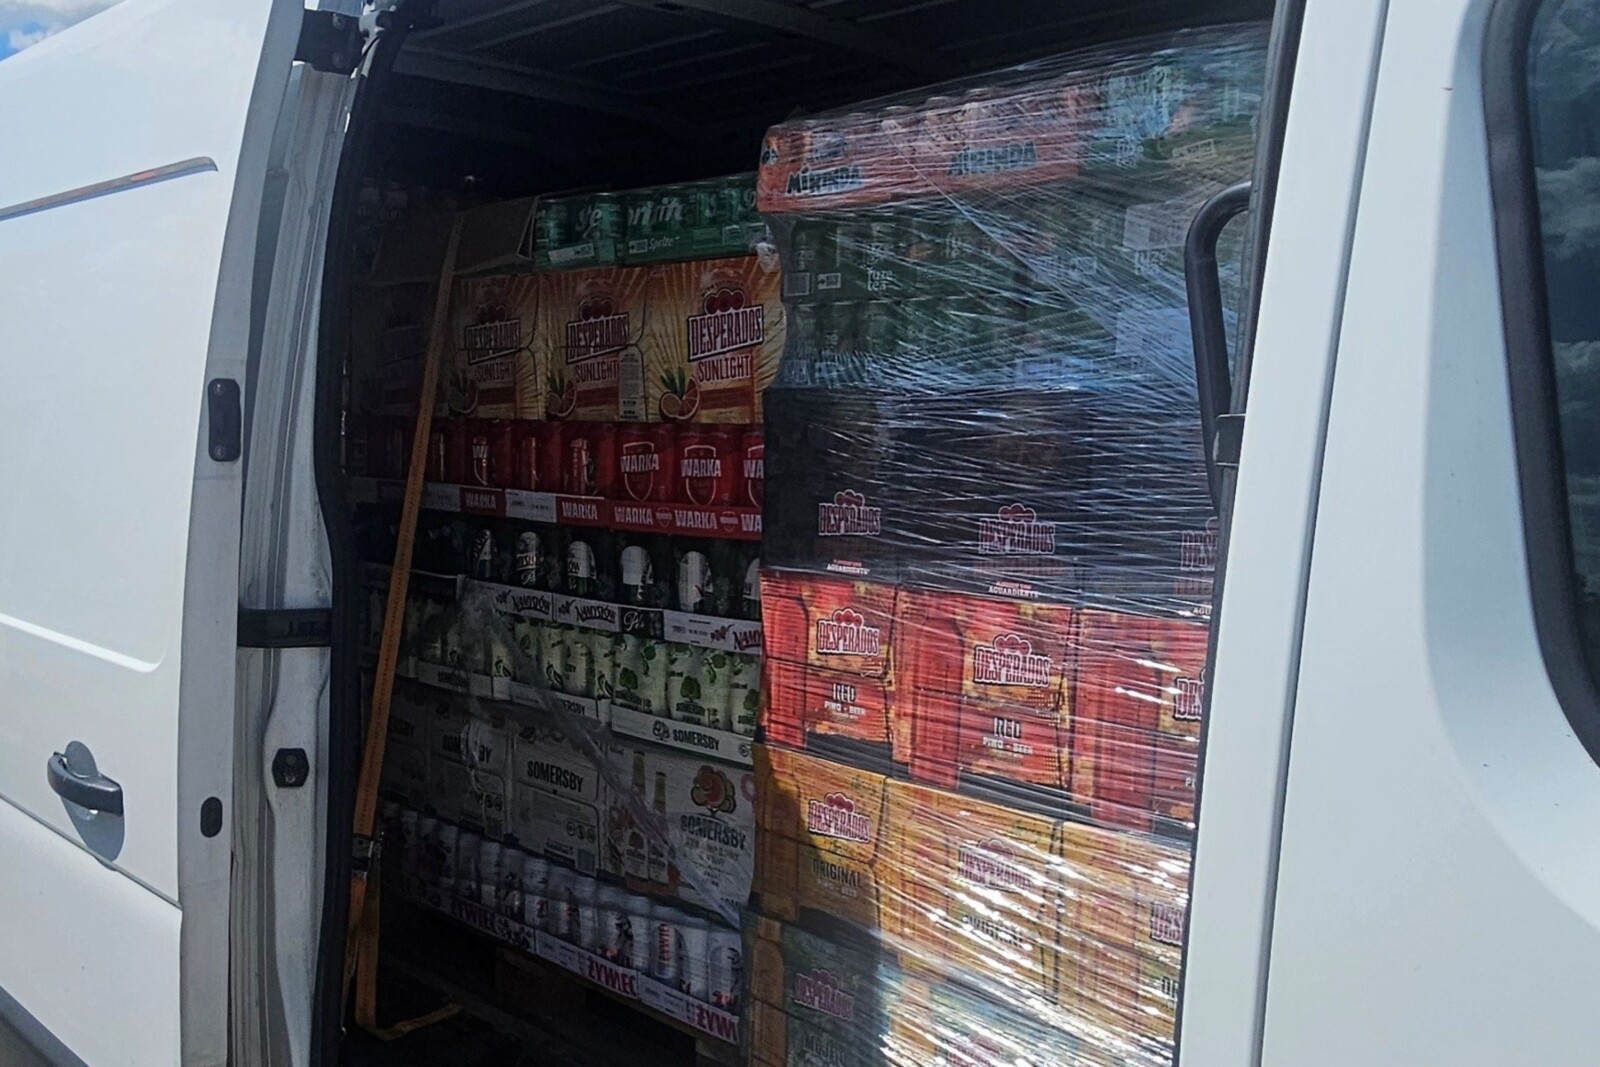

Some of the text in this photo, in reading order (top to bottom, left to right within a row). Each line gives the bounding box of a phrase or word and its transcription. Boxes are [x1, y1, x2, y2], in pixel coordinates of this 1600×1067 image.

[568, 316, 628, 362] DESPERADOS
[690, 307, 762, 357] DESPERADOS
[575, 360, 620, 383] SUNLIGHT
[698, 355, 750, 383] SUNLIGHT
[620, 453, 660, 473] WARKA
[680, 458, 722, 478] WARKA
[464, 492, 497, 510] WARKA
[561, 501, 599, 520] WARKA
[614, 506, 654, 525] WARKA
[674, 509, 718, 530] WARKA
[819, 504, 880, 535] DESPERADOS
[979, 518, 1055, 554] DESPERADOS
[818, 621, 880, 655] DESPERADOS
[976, 648, 1050, 687] DESPERADOS
[673, 729, 719, 751] SOMERSBY
[526, 760, 584, 793] SOMERSBY
[680, 814, 746, 850] SOMERSBY
[809, 800, 870, 843] DESPERADOS
[812, 859, 861, 888] ORIGINAL
[587, 957, 637, 997] ŻYWIEC
